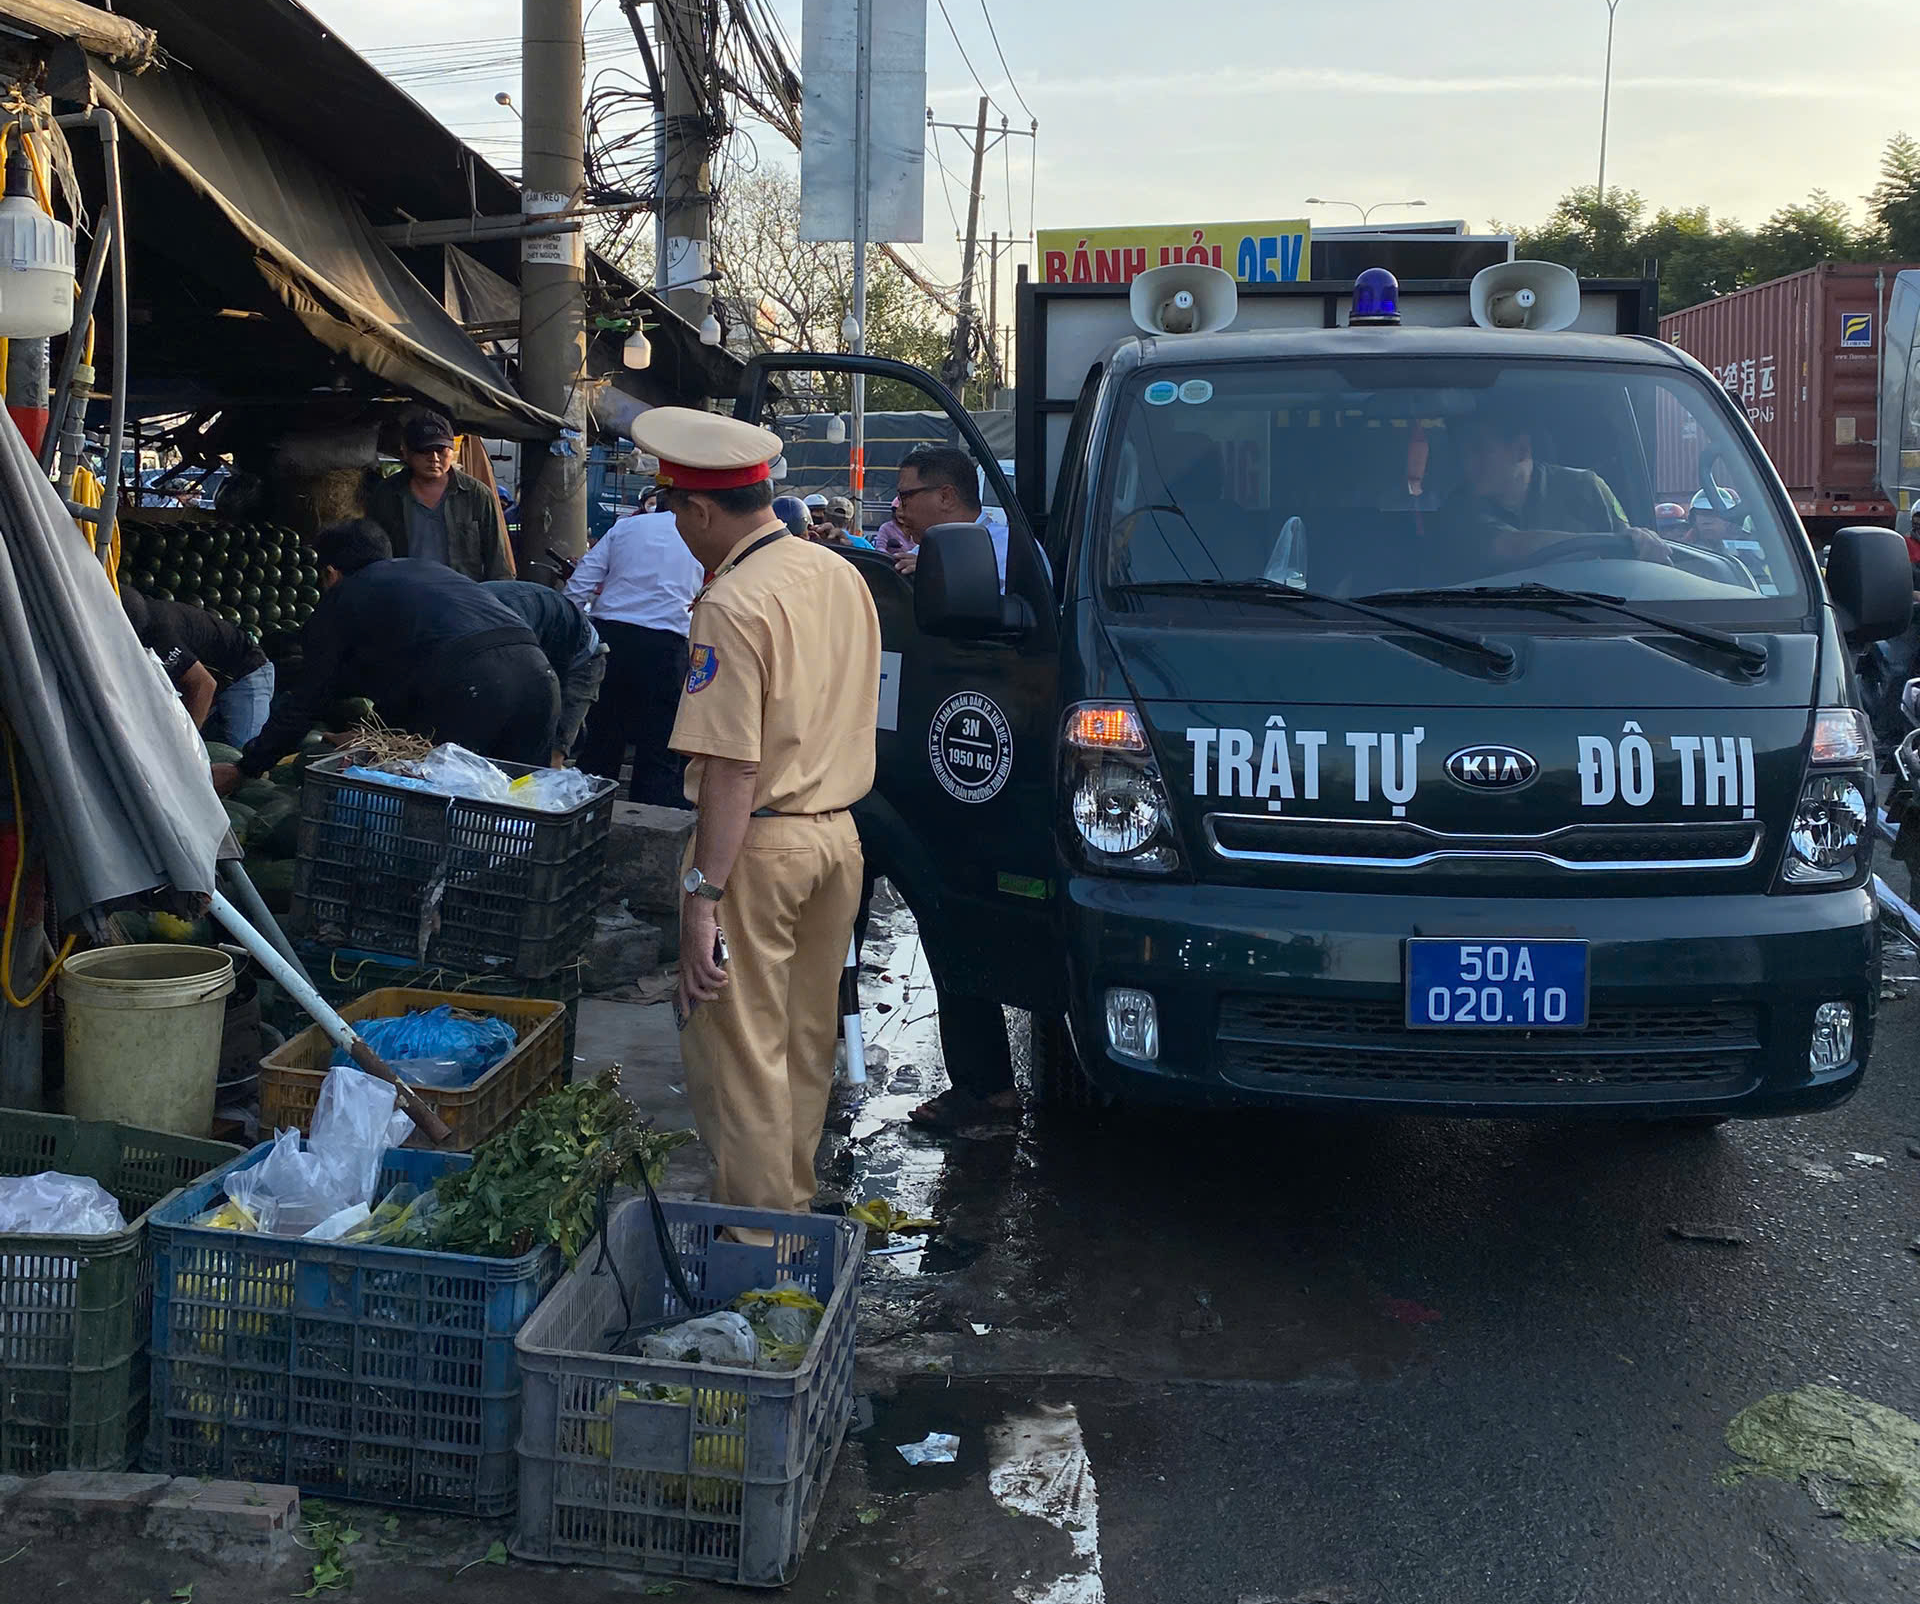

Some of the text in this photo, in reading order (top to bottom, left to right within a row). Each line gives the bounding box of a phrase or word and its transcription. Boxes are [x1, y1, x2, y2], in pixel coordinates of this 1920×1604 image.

[962, 717, 981, 737] 3N
[948, 747, 992, 771] 1950 KG
[1186, 715, 1756, 820] TRẬT TỰ ĐÔ THỊ
[1461, 755, 1524, 781] KIA
[1460, 946, 1535, 982] 50A
[1428, 986, 1567, 1022] 020.10
